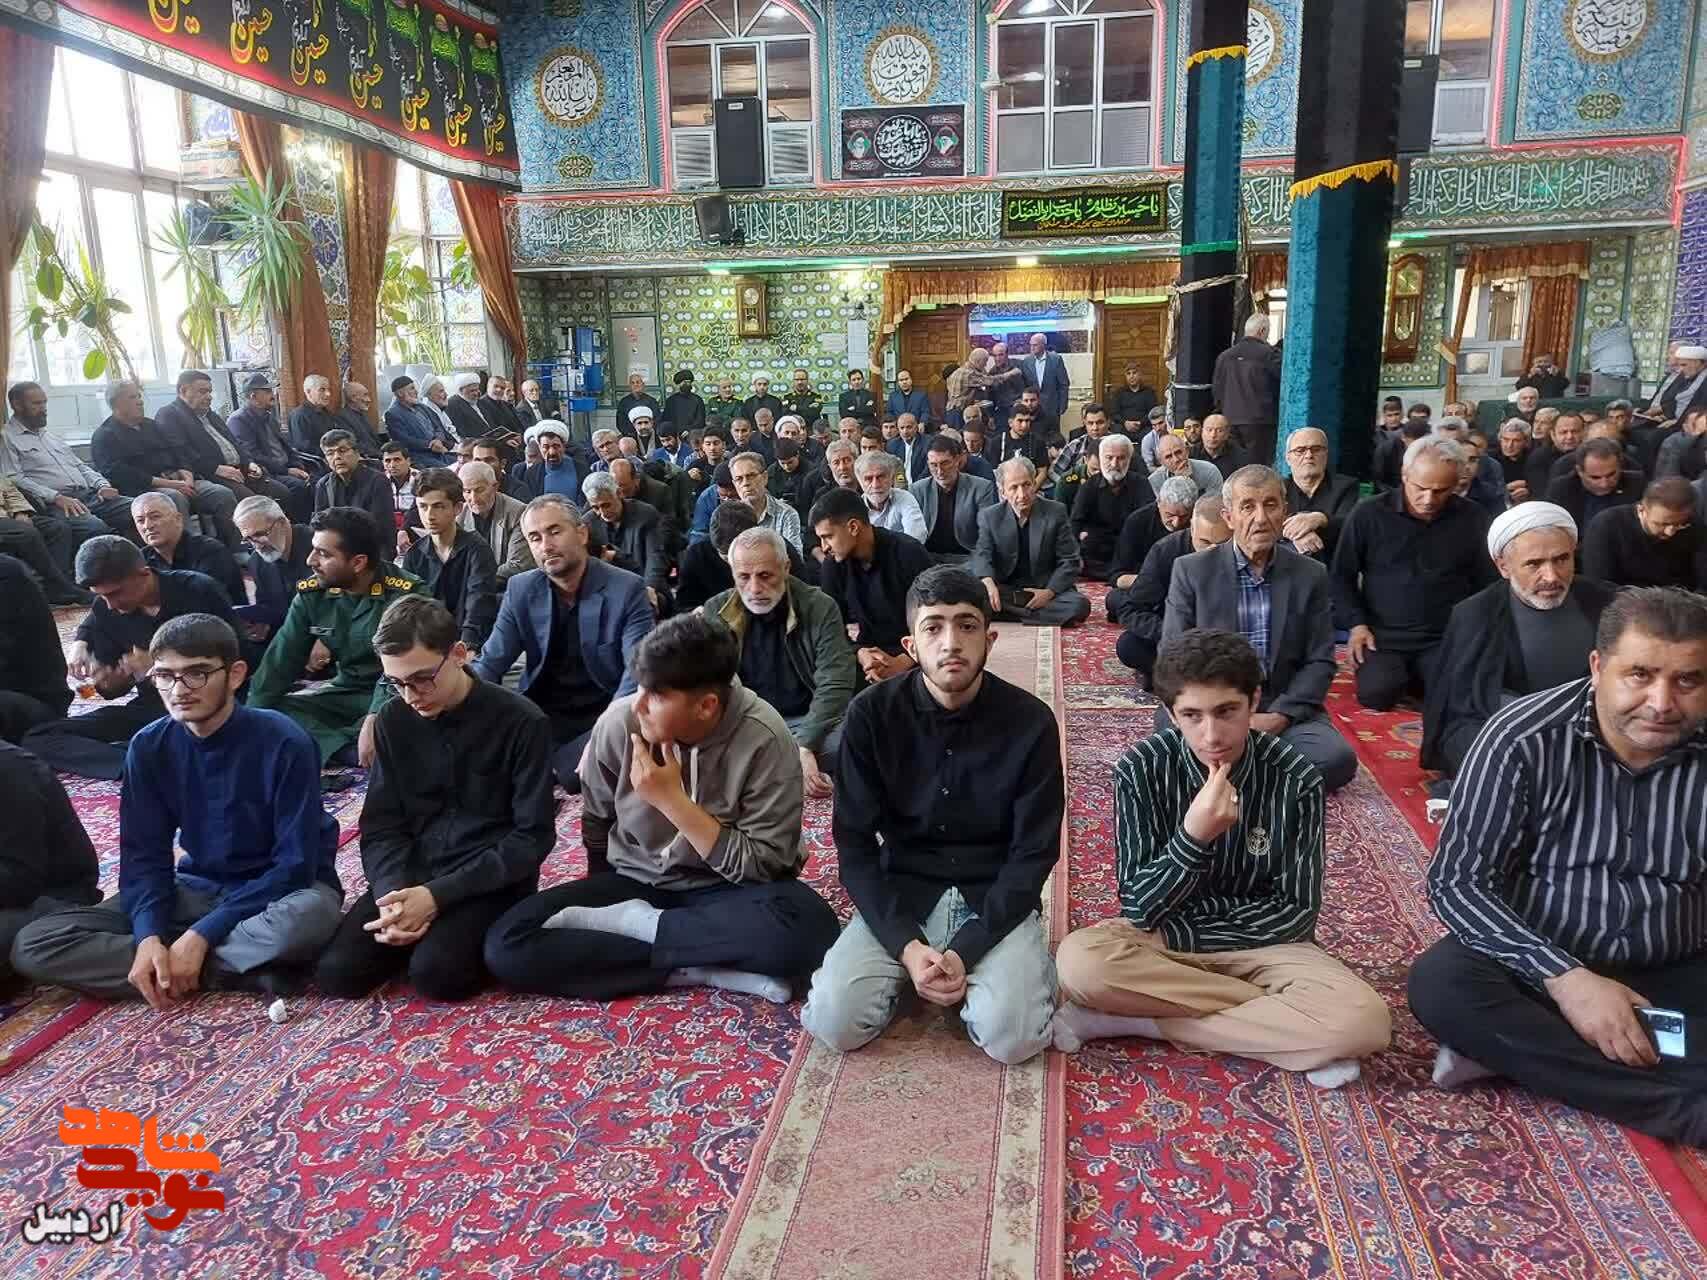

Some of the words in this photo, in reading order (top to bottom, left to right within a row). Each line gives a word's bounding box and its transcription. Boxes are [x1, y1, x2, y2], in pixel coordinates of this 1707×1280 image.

[231, 8, 272, 64] حسین
[291, 33, 329, 86] حسین
[351, 64, 384, 109] حسین
